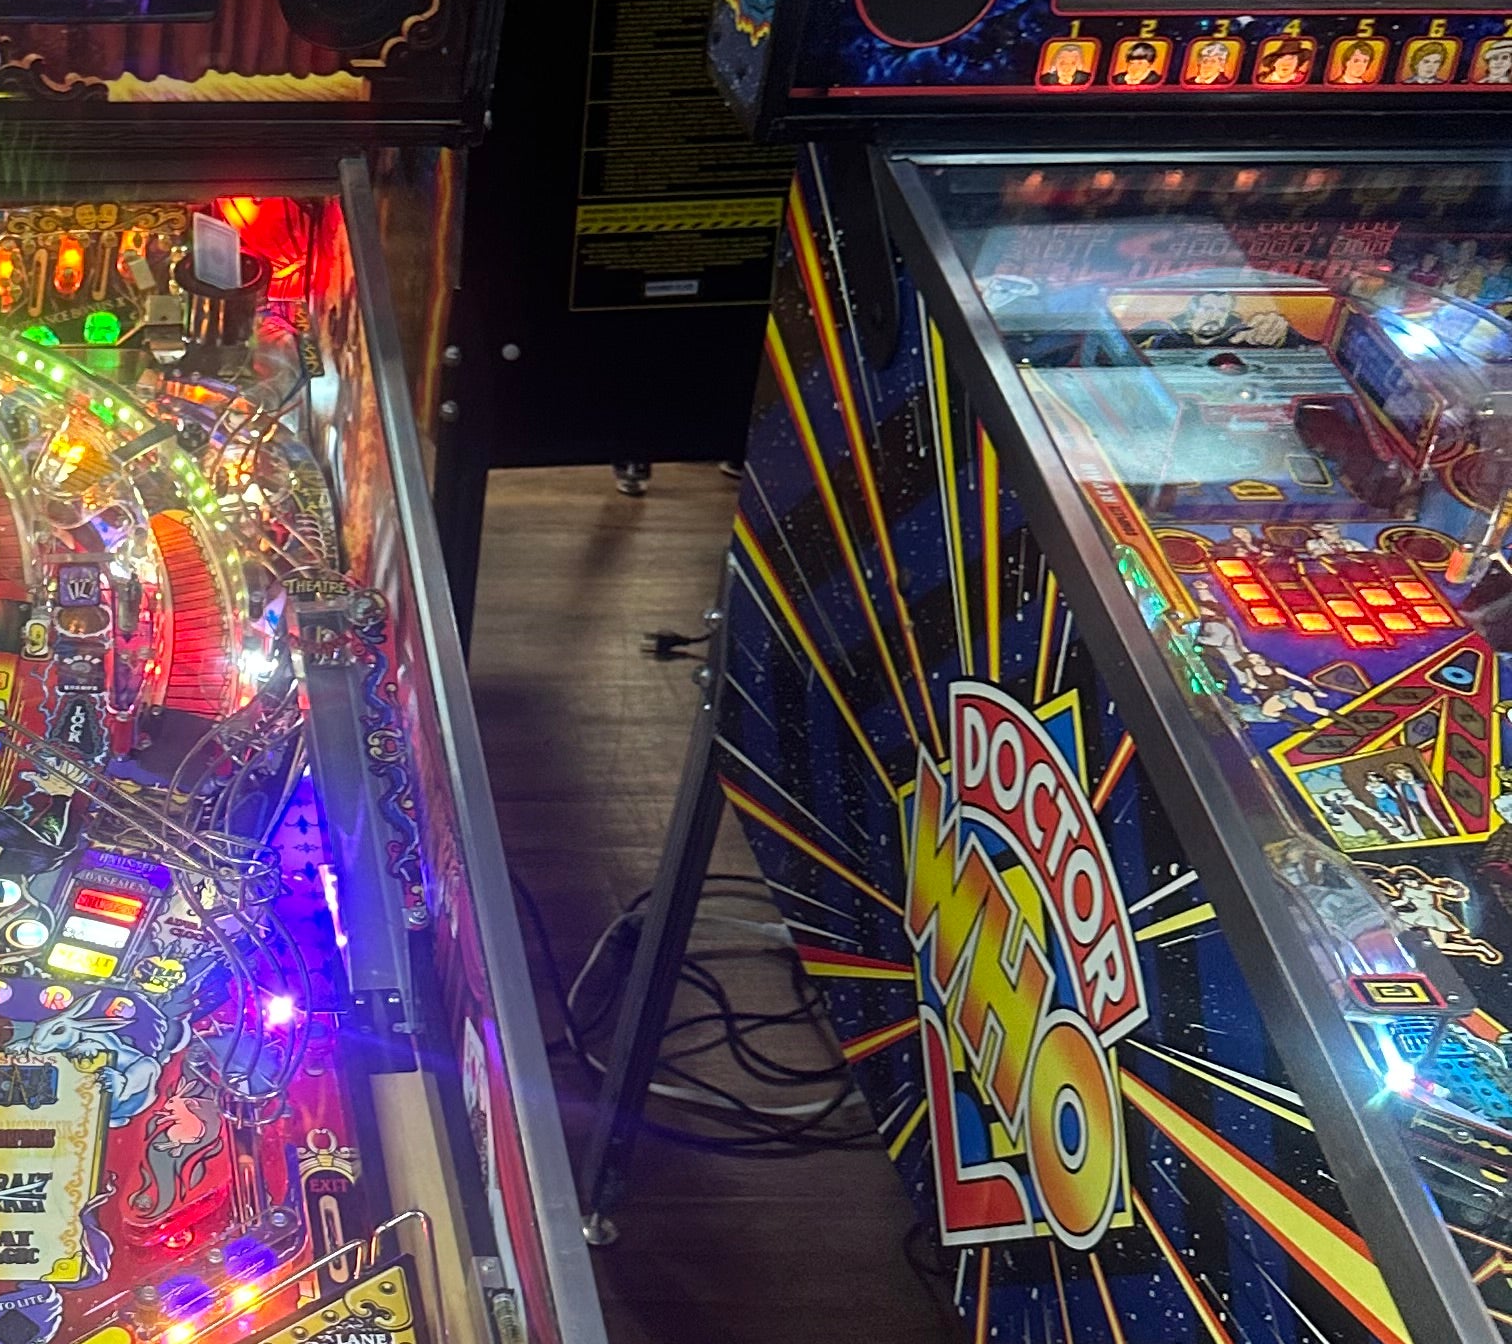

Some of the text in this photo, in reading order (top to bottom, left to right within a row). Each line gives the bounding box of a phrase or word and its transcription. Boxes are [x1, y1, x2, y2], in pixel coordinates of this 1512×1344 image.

[1068, 20, 1083, 38] 1
[1139, 20, 1159, 38] 2
[1213, 20, 1232, 38] 3
[1283, 20, 1302, 38] 4
[1357, 19, 1376, 38] 5
[1428, 19, 1448, 38] 6
[284, 577, 349, 596] THEATRE
[67, 705, 86, 744] LOCK
[962, 704, 1126, 1029] DOCTOR
[904, 743, 1121, 1251] WHO
[309, 1177, 350, 1195] EXIT
[16, 1293, 46, 1308] LITE
